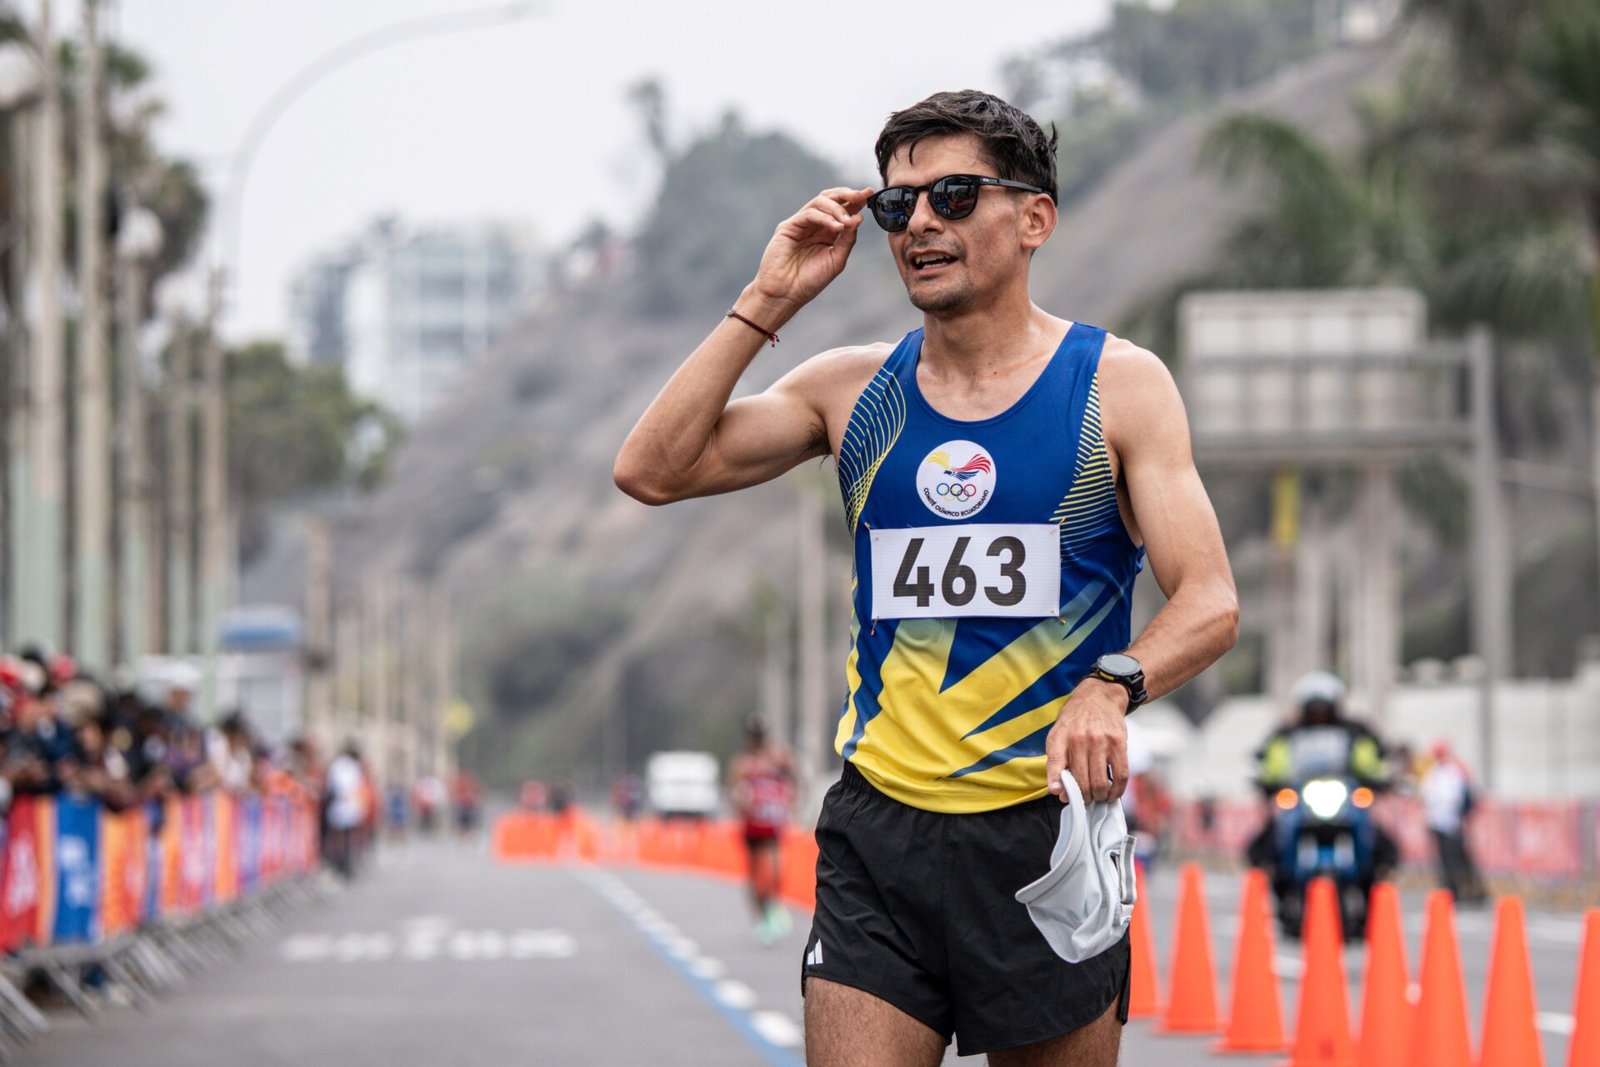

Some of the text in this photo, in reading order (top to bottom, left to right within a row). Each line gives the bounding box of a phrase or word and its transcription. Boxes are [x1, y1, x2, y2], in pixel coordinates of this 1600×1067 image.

[924, 487, 936, 506] COMITÉ
[961, 490, 988, 516] ECUATORIANO
[893, 536, 1027, 607] 463
